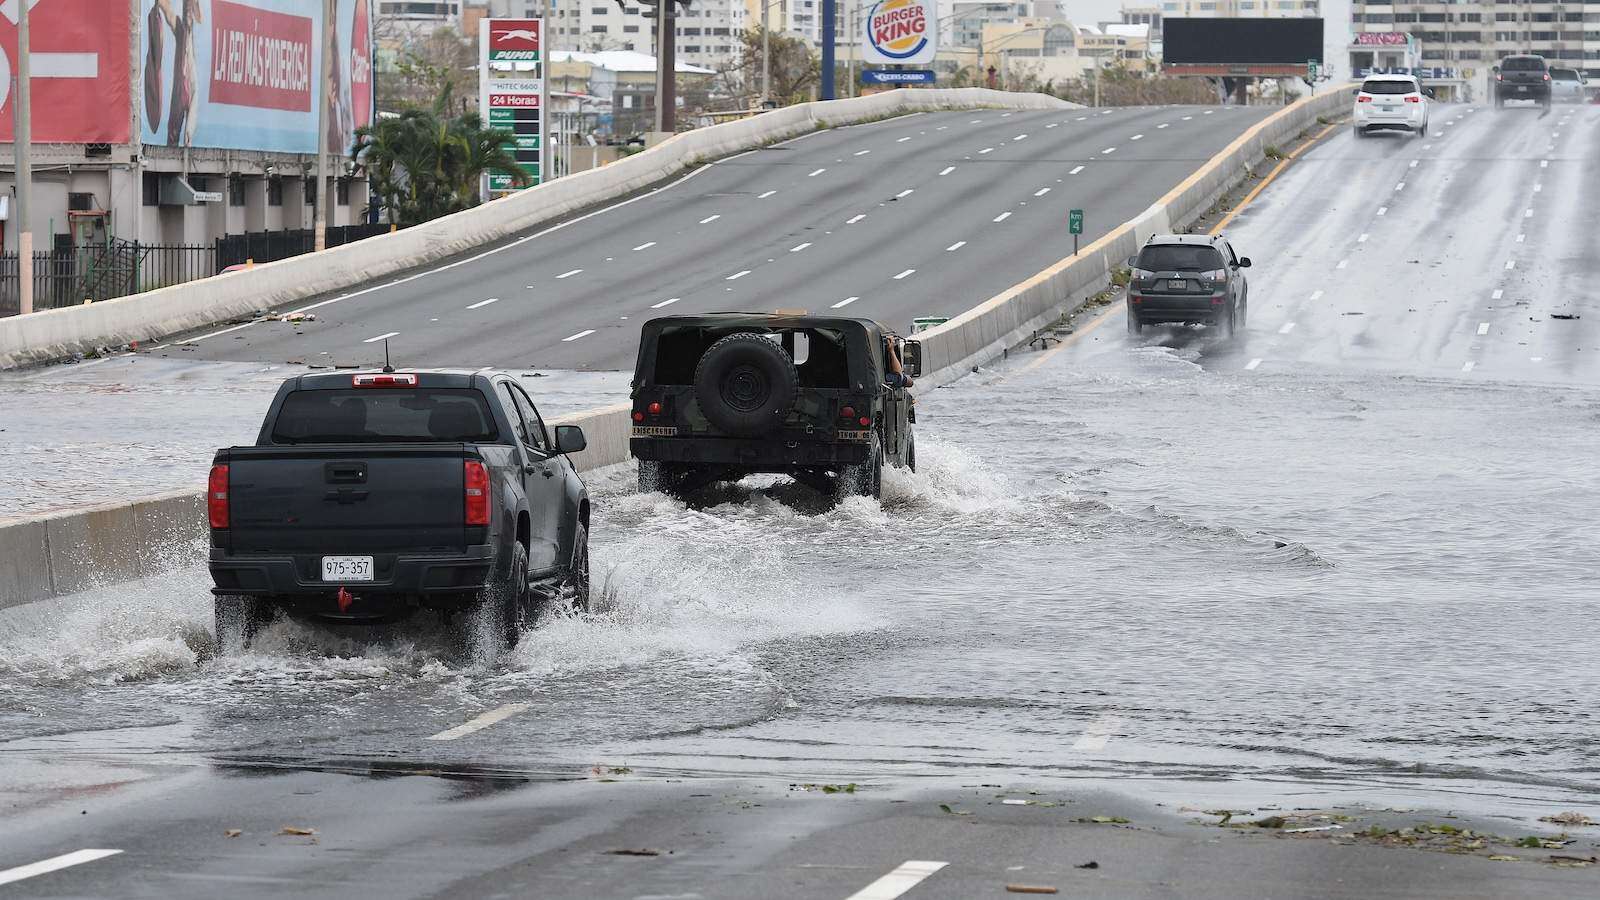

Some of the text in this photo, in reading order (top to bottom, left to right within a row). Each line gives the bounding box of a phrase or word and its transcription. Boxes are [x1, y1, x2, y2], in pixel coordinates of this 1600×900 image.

[874, 6, 924, 29] BURGER
[875, 17, 926, 45] KING
[215, 18, 309, 92] LA RED MÁS PODEROSA
[494, 50, 535, 60] PUMA
[492, 95, 537, 105] 24 Horas
[1073, 220, 1080, 231] 4
[326, 561, 369, 575] 975-357
